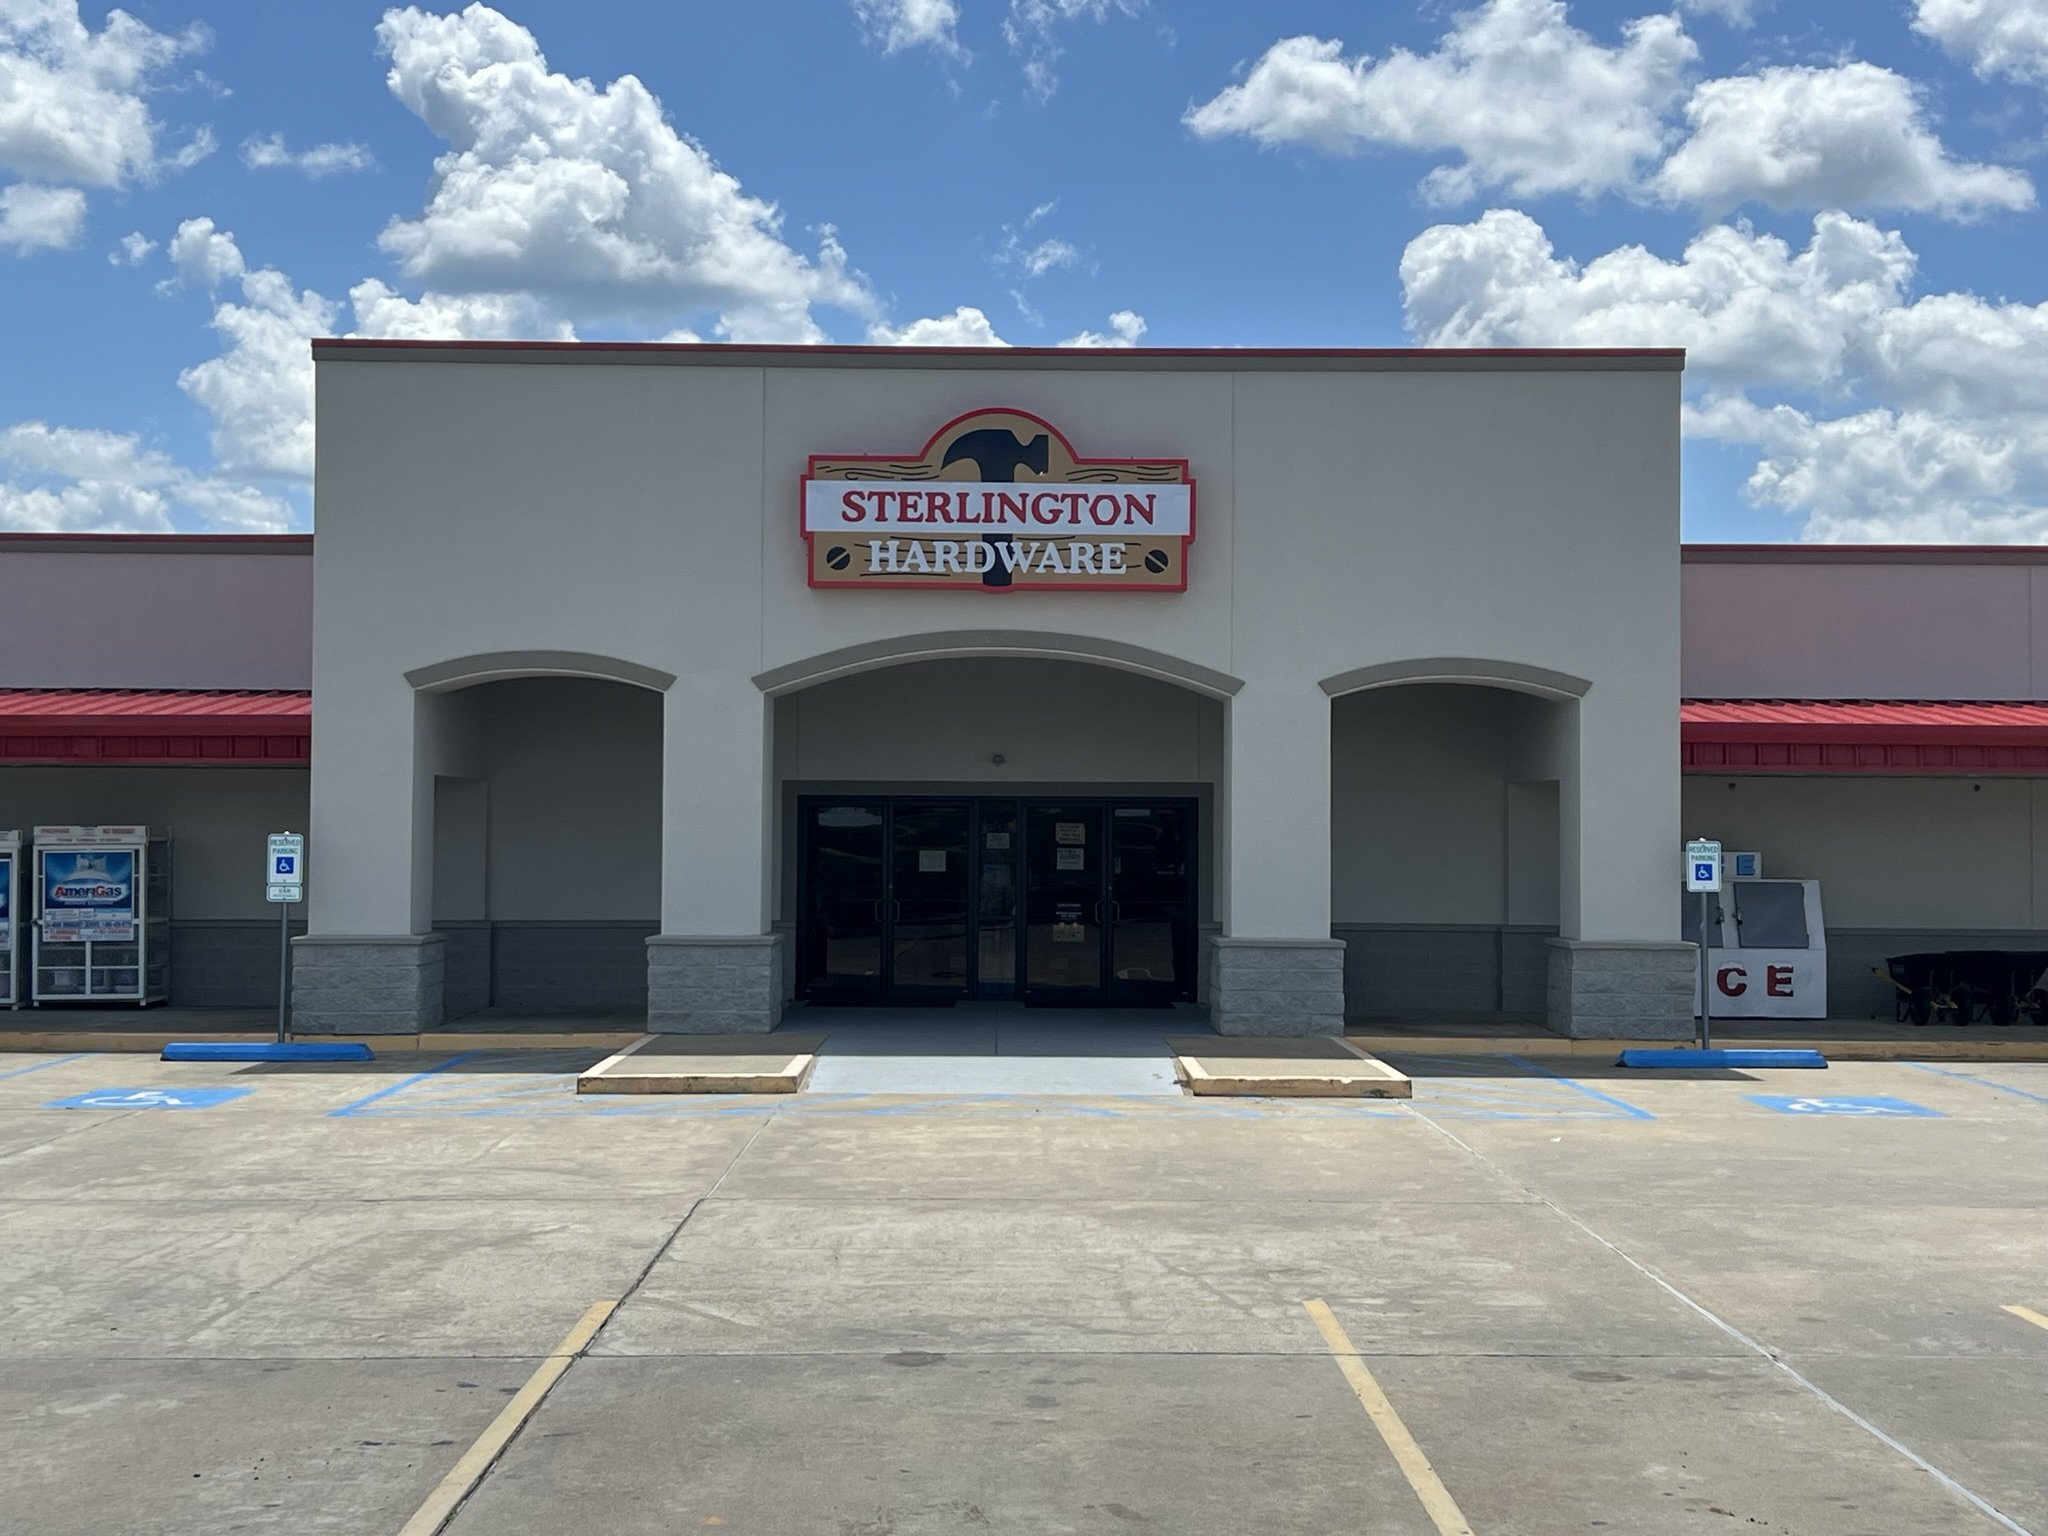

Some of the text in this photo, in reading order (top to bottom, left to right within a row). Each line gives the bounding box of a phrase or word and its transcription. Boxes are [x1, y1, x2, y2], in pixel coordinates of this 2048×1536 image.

[841, 490, 1156, 526] STERLINGTON
[868, 538, 1127, 574] HARDWARE
[270, 838, 300, 846] RESERVED
[1688, 845, 1719, 853] RESERVED
[54, 885, 122, 897] AmeriGas
[1716, 960, 1795, 997] CE
